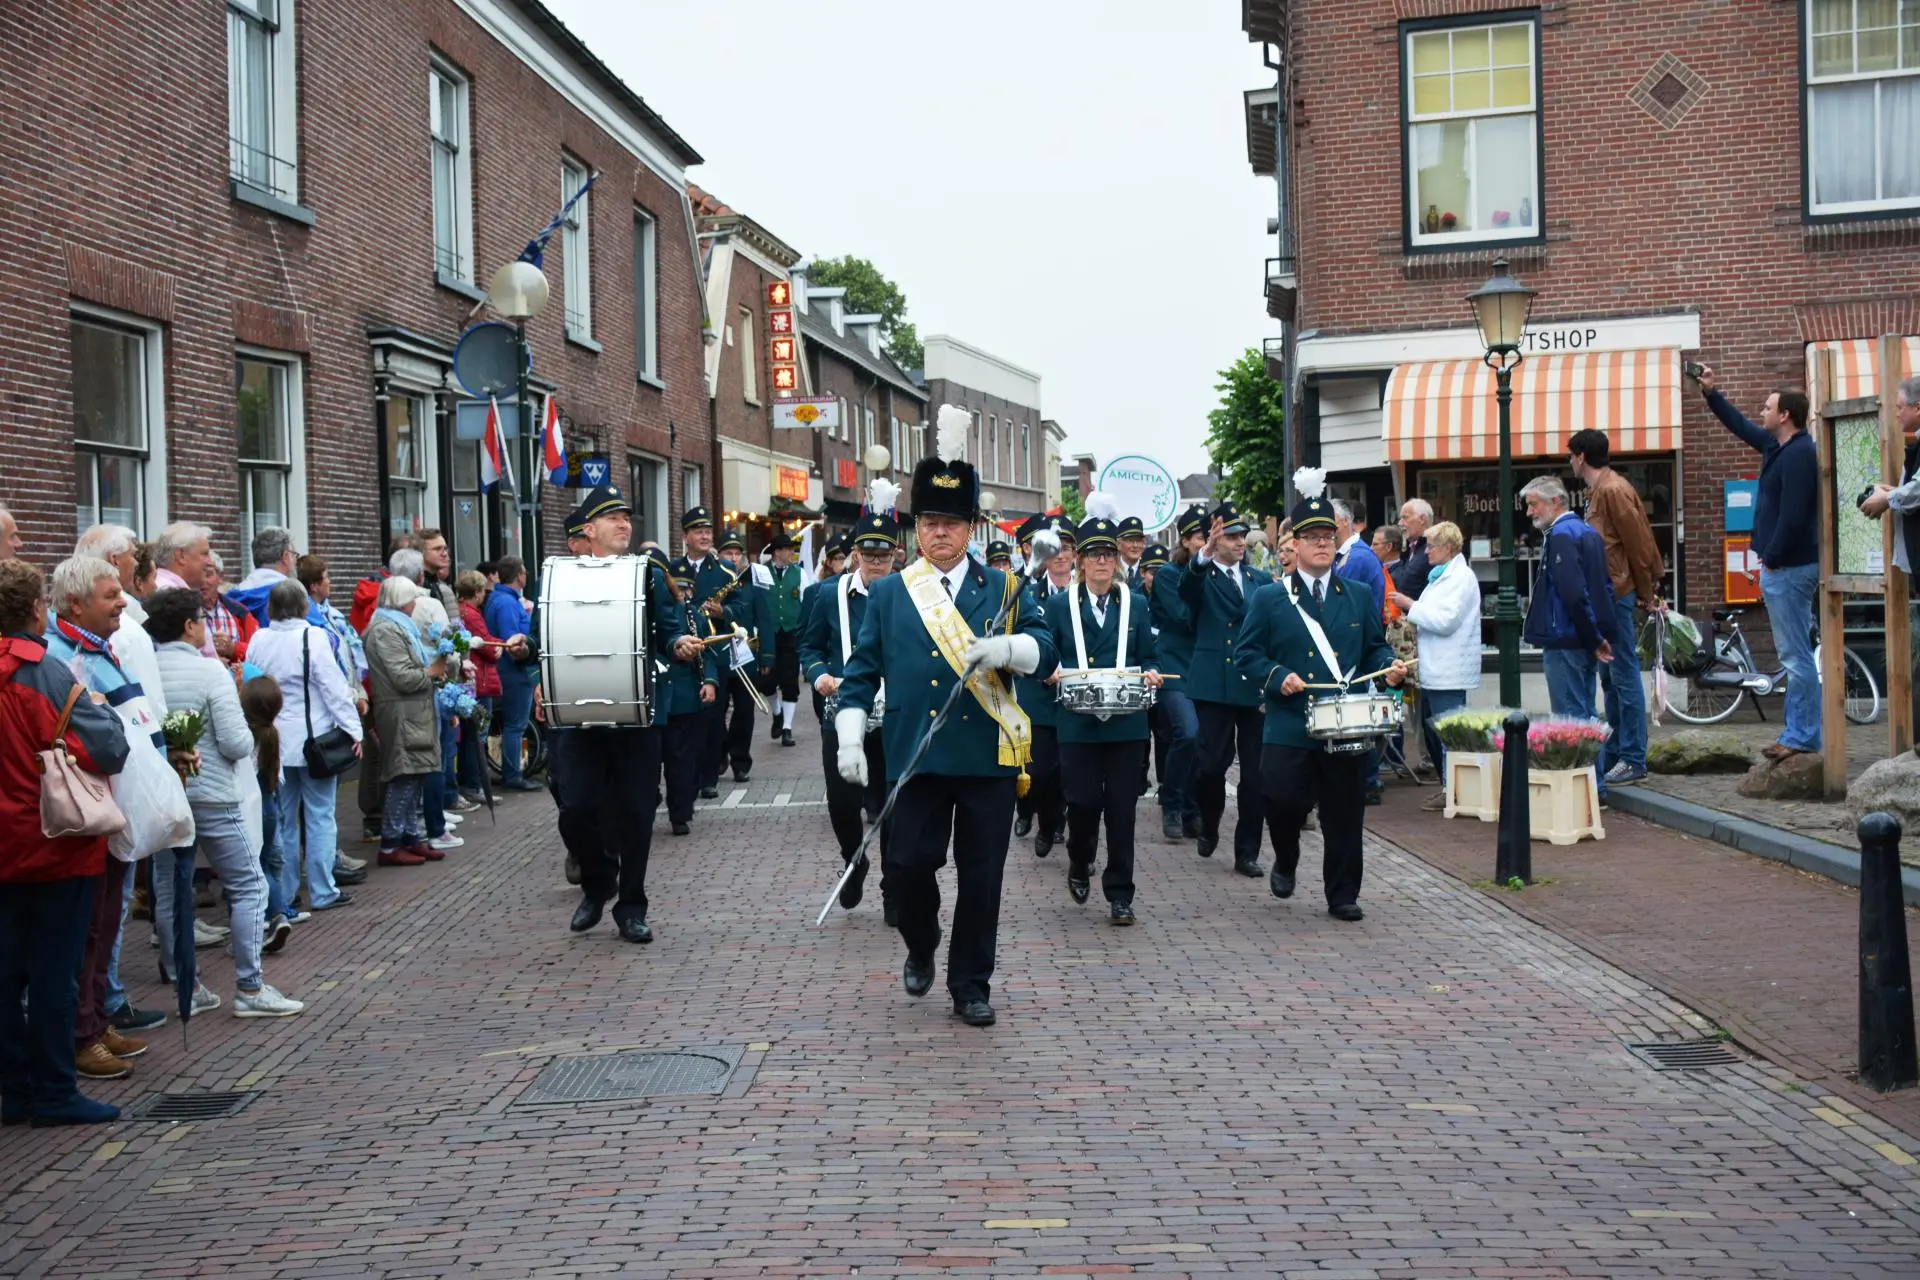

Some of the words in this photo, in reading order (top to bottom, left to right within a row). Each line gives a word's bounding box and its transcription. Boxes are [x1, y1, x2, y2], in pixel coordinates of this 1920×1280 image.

[1518, 328, 1597, 351] TSHOP
[1109, 470, 1163, 483] AMICITIA
[1464, 493, 1522, 516] Boetk
